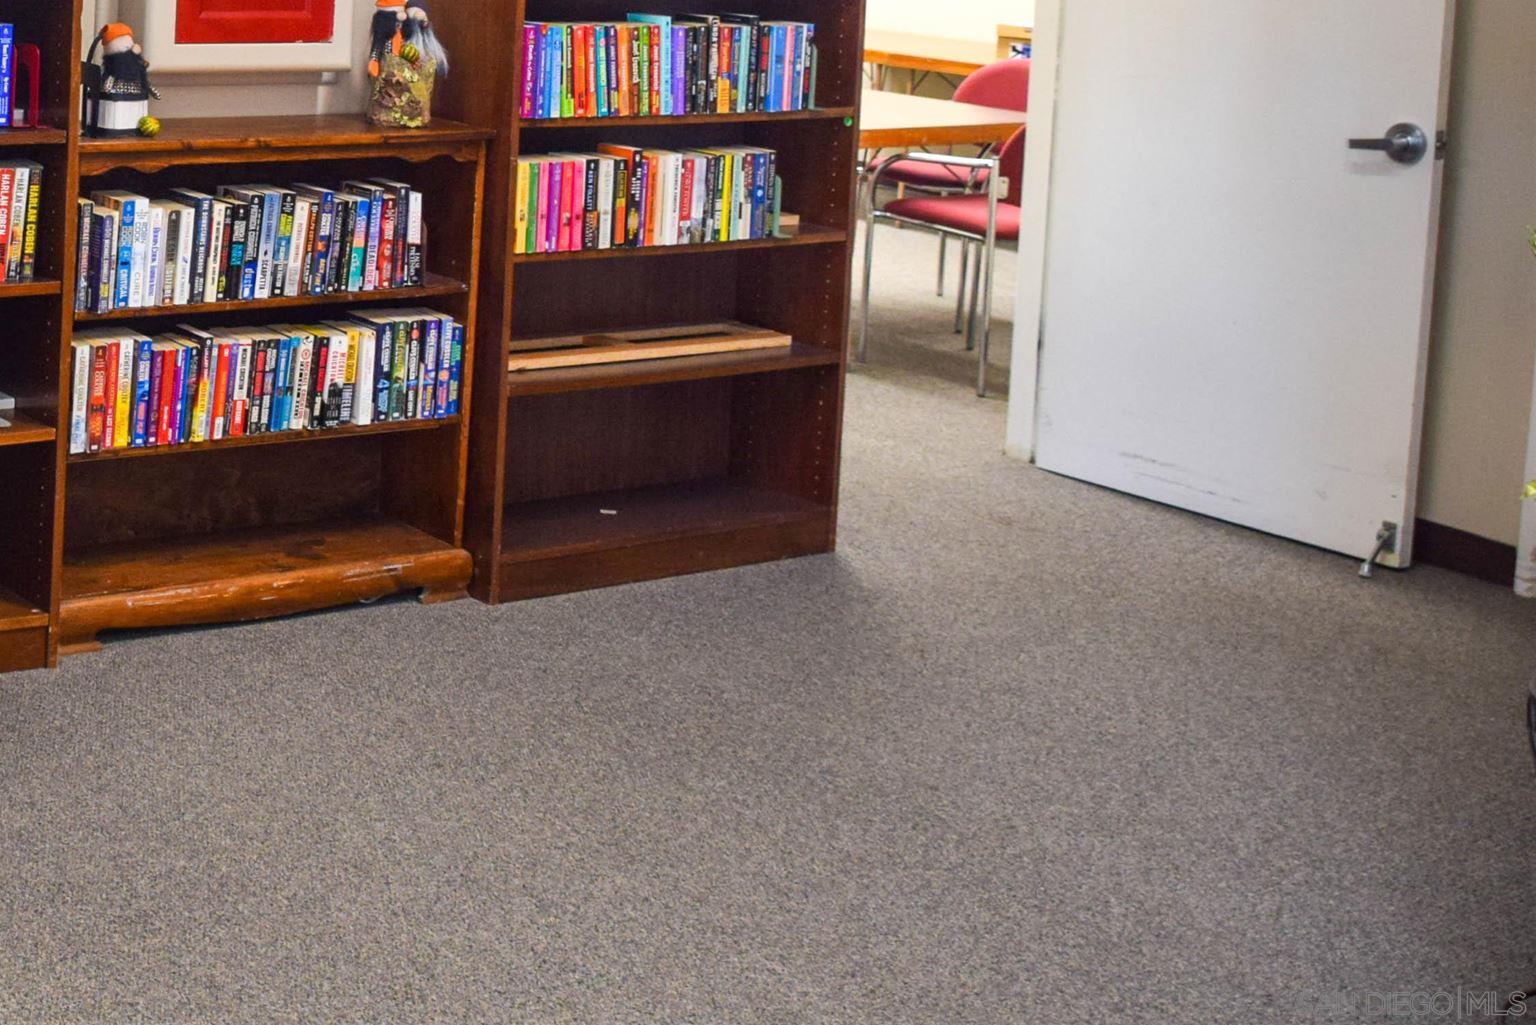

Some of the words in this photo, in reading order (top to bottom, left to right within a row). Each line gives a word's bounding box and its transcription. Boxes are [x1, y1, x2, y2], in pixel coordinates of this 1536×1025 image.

[0, 174, 10, 206] HARLAN
[15, 178, 24, 204] HARLAN
[28, 185, 39, 222] HARLAN
[13, 206, 22, 227] COBEN
[25, 224, 36, 254] COBEN
[244, 268, 255, 288] dust
[259, 259, 268, 290] SCARPETTA
[366, 245, 376, 284] DEADLOCK
[122, 352, 130, 379] CATHERINE
[240, 348, 248, 367] MICHAEL
[337, 352, 346, 380] MICHAEL
[444, 341, 452, 368] CUSSLER
[121, 381, 129, 403] COULTER
[238, 368, 246, 390] CRICHTON
[298, 390, 307, 420] CRICHTON
[340, 385, 352, 421] TIMELINE
